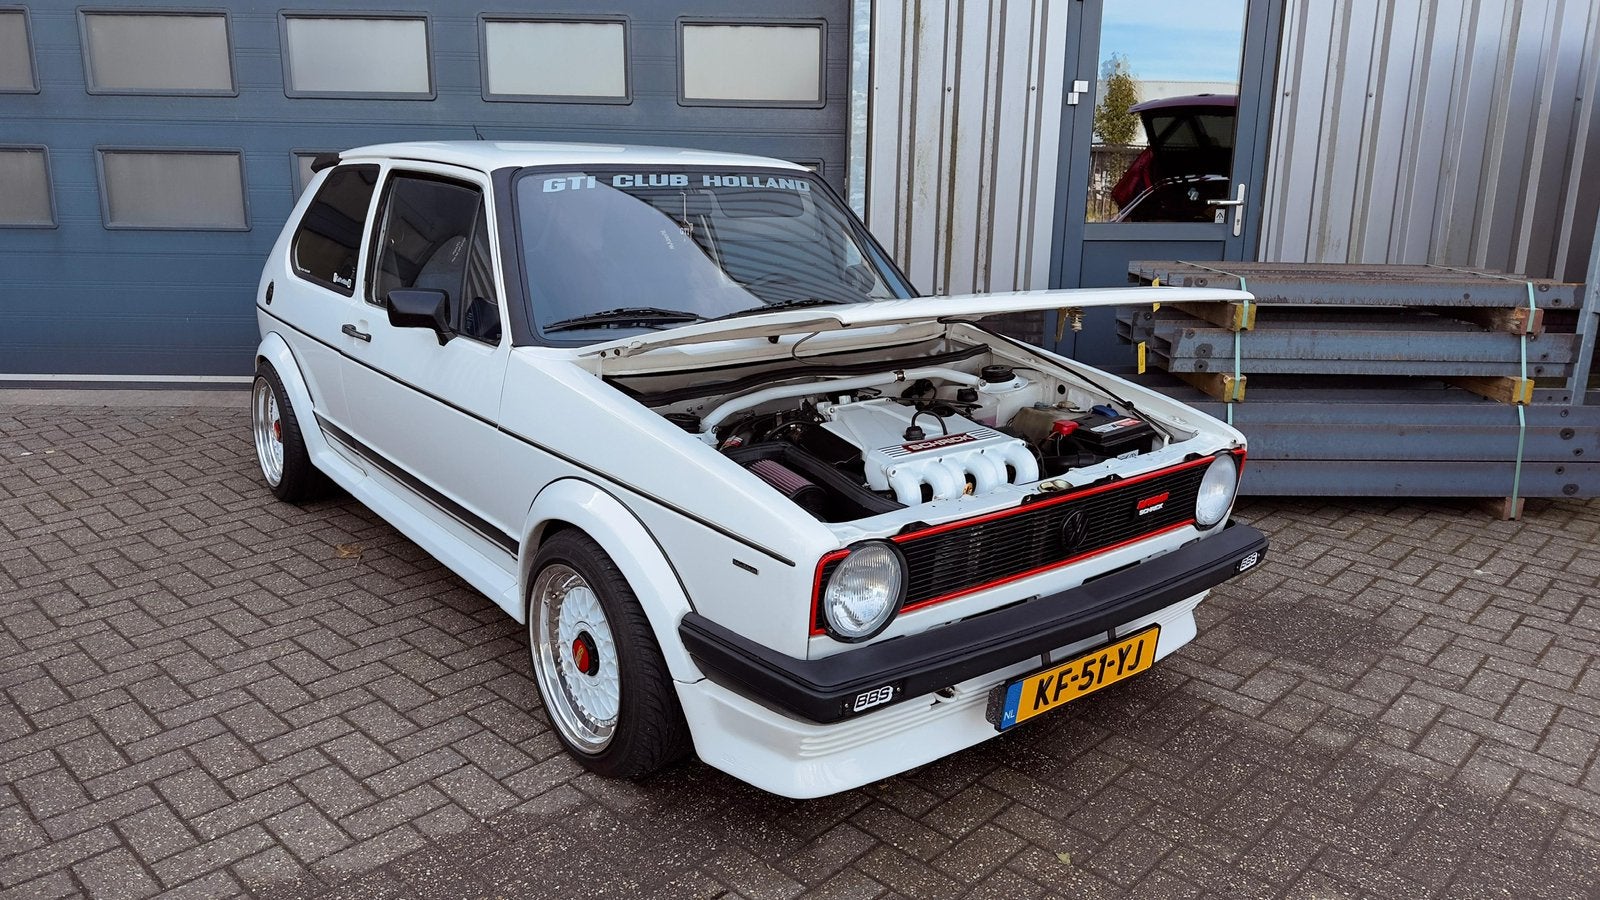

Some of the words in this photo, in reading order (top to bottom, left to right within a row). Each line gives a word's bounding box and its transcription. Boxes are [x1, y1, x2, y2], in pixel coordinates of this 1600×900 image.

[542, 175, 596, 193] GTI
[612, 174, 689, 188] CLUB
[702, 175, 811, 192] HOLLAND
[908, 434, 974, 451] SCHRICK
[1240, 551, 1258, 572] BBS
[1033, 639, 1144, 711] KF-51-YJ
[854, 685, 894, 712] BBS
[1003, 709, 1015, 722] NL
